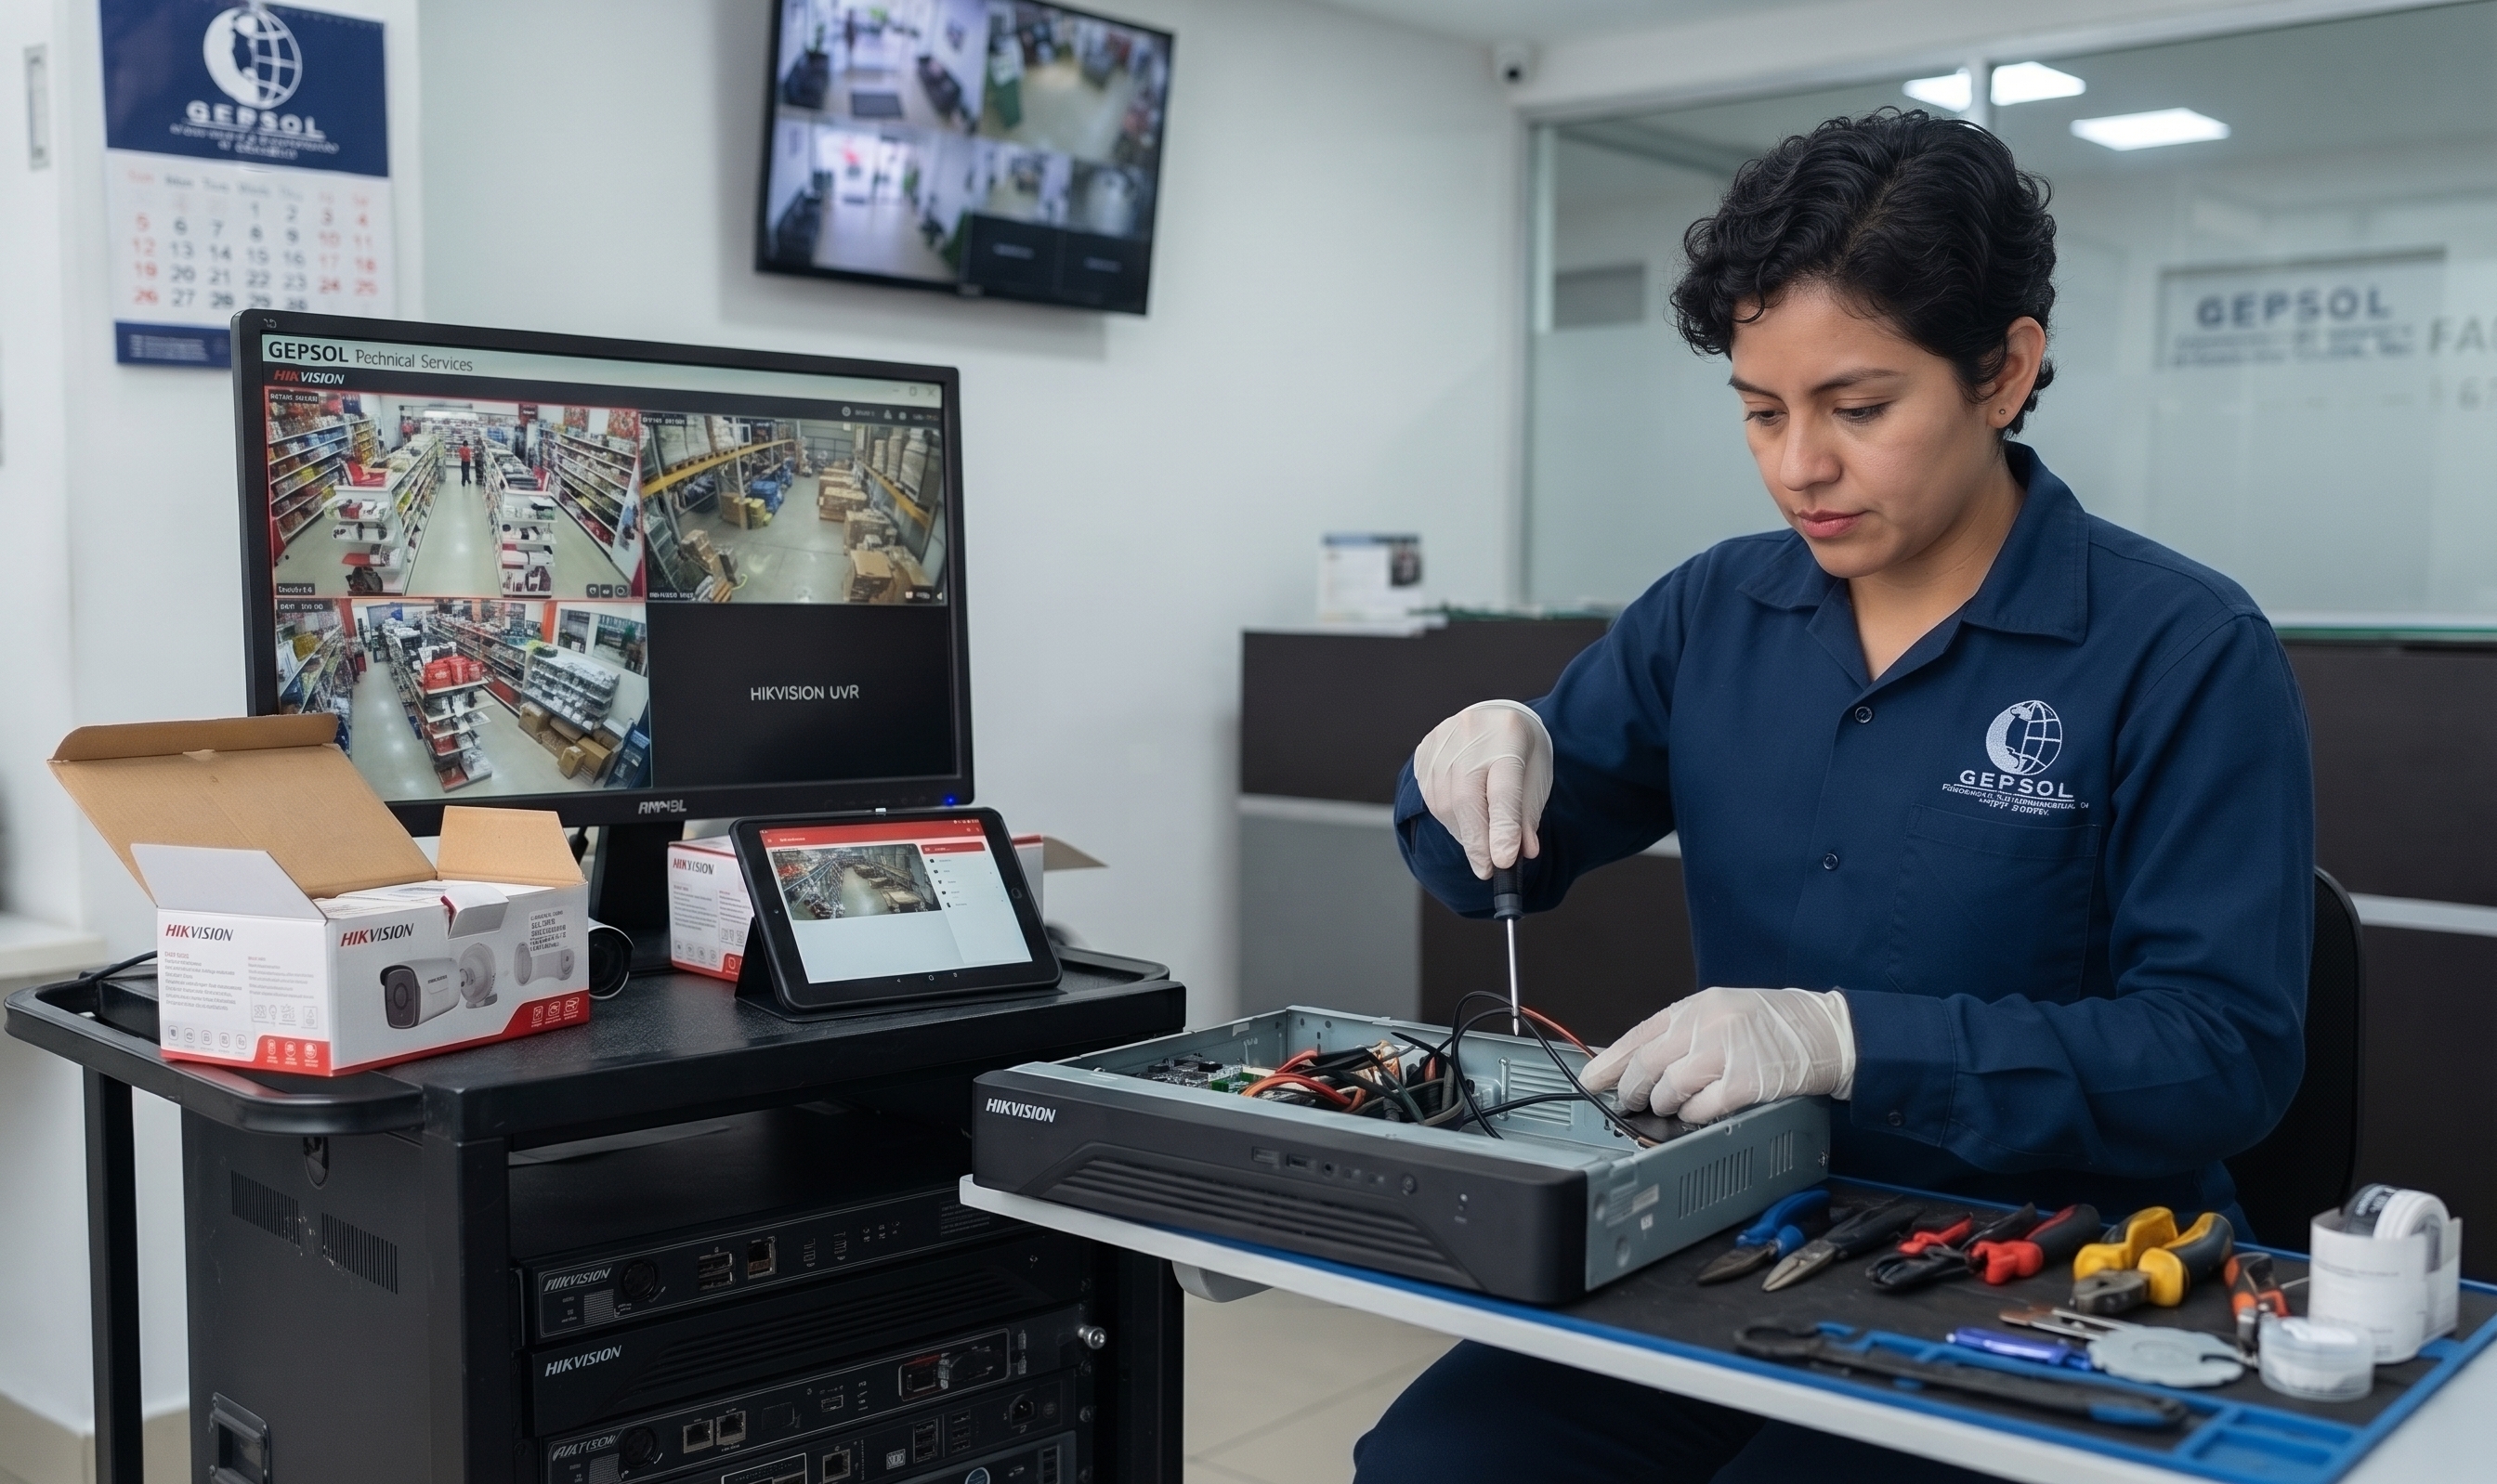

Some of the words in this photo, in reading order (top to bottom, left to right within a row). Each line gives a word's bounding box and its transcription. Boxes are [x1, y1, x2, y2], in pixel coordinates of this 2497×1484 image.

[186, 99, 325, 139] GEPSOL
[287, 203, 298, 222] 2
[321, 208, 333, 225] 3
[137, 212, 150, 232] 5
[174, 215, 188, 234] 6
[210, 218, 224, 237] 7
[251, 224, 262, 241] 8
[286, 228, 299, 245] 9
[319, 230, 341, 248] 10
[354, 233, 372, 249] 11
[133, 237, 155, 256] 12
[171, 240, 193, 259] 13
[210, 243, 231, 261] 14
[247, 246, 269, 266] 15
[283, 250, 306, 268] 16
[319, 253, 340, 269] 17
[355, 257, 376, 274] 18
[135, 261, 158, 280] 19
[170, 264, 196, 283] 20
[208, 267, 230, 285] 21
[247, 269, 270, 288] 22
[283, 273, 307, 292] 23
[319, 277, 341, 294] 24
[354, 279, 378, 296] 25
[134, 286, 159, 306] 26
[171, 288, 196, 307] 27
[210, 291, 235, 310] 28
[2195, 283, 2394, 329] GEPSOL
[2428, 317, 2497, 355] FA
[268, 341, 349, 363] GEPSOL
[421, 354, 473, 372] Services
[273, 370, 346, 384] HIKVISION
[751, 685, 825, 701] HIKVISION
[830, 683, 860, 700] UVR
[1959, 769, 2074, 799] GEPSOL
[164, 923, 234, 942] HIKVISION
[340, 922, 414, 947] HIKVISION
[985, 1098, 1056, 1123] HIKVISION
[544, 1344, 622, 1377] HIKVISION
